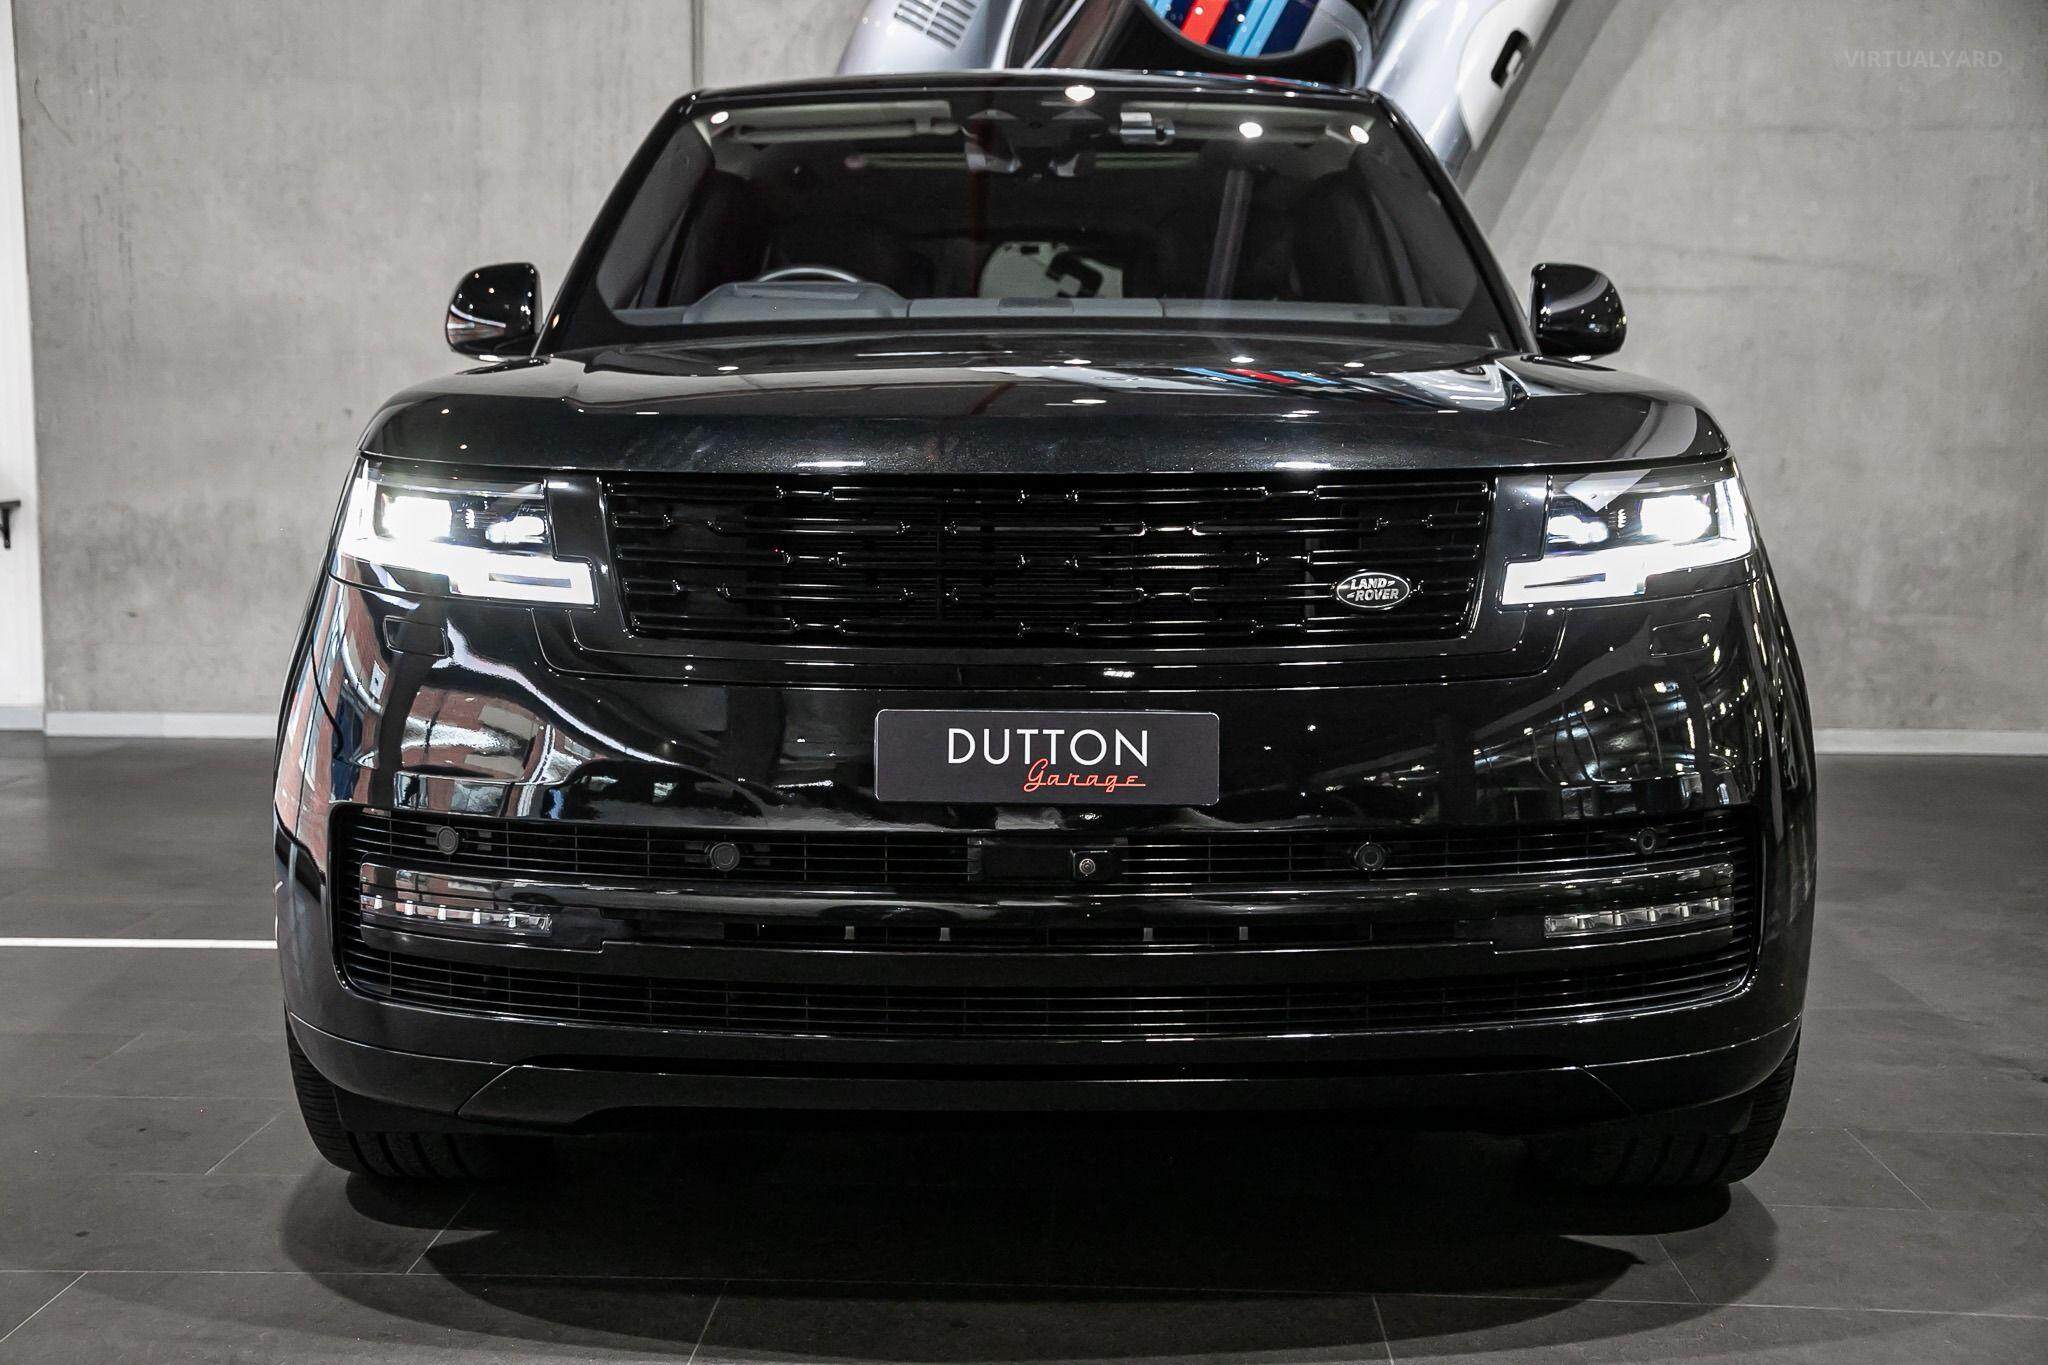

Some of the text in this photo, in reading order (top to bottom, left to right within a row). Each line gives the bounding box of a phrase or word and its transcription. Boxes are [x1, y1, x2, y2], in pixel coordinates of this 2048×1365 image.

[1350, 577, 1387, 591] LAND
[1354, 588, 1399, 602] ROVER
[948, 728, 1148, 767] DUTTON
[1023, 758, 1147, 793] Garage
